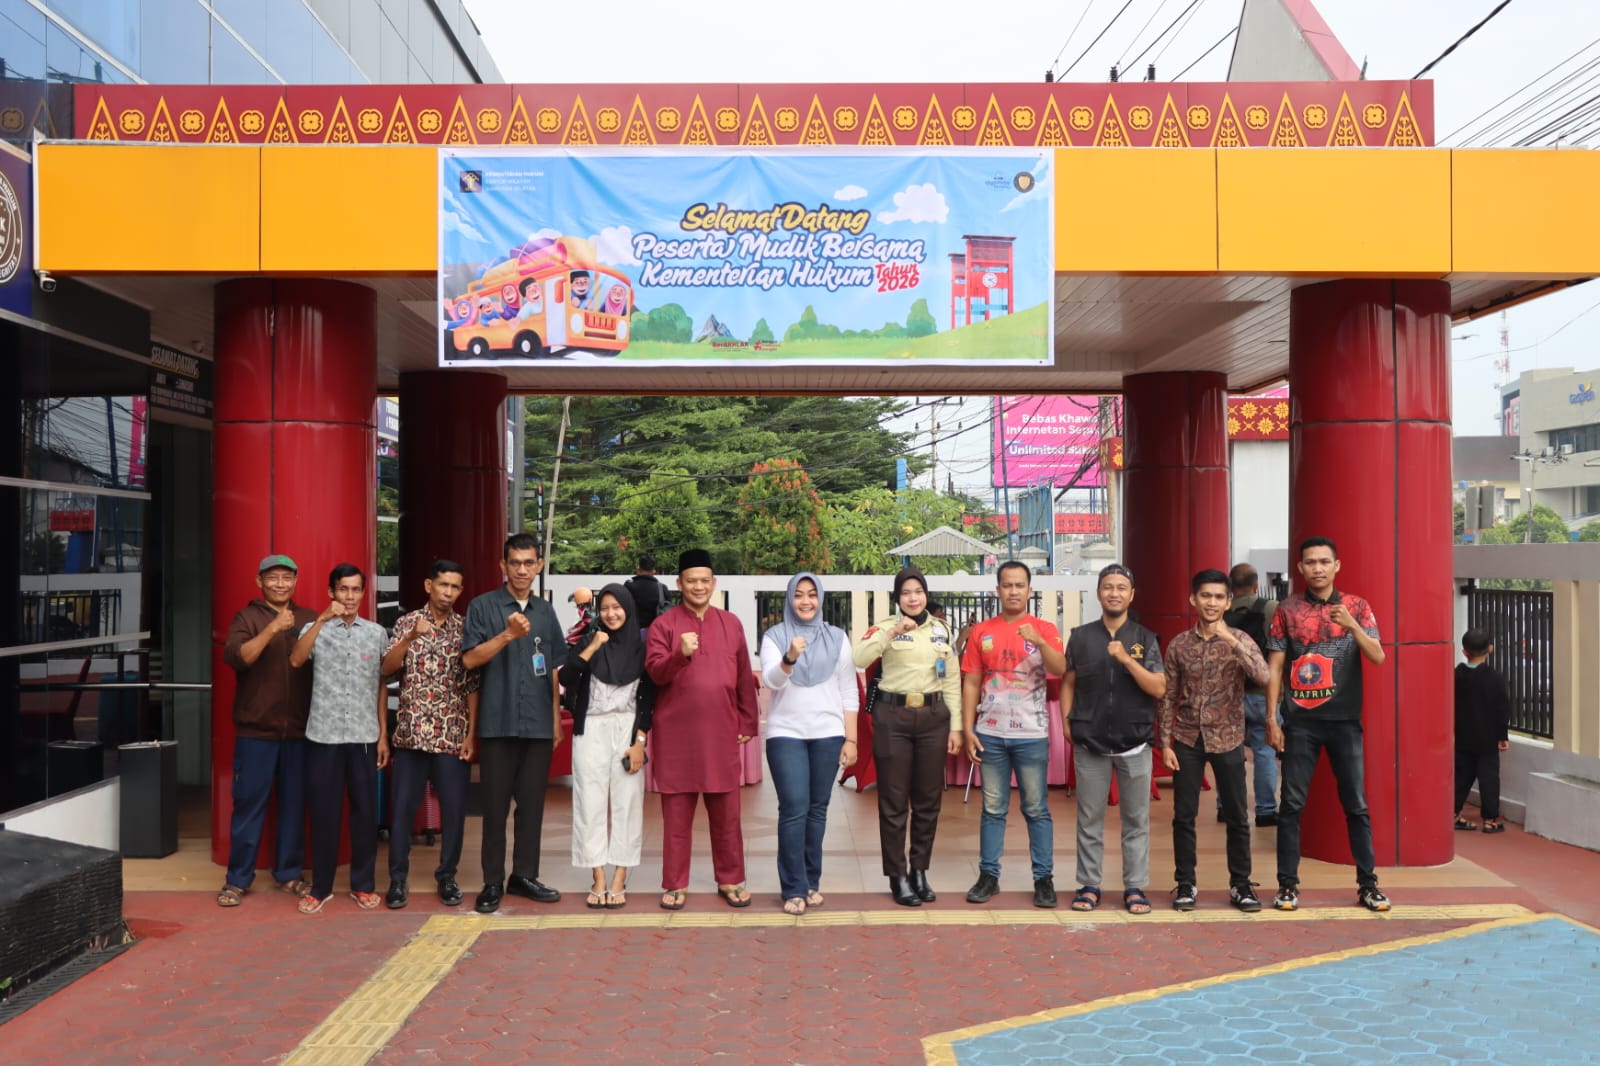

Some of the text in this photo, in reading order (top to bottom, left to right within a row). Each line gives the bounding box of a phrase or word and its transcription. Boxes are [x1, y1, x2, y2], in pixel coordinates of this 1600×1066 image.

[680, 202, 871, 236] Selamat Datang
[632, 231, 927, 265] Peserta Mudik Bersama
[640, 259, 873, 292] Kementerian Hukum
[875, 262, 920, 280] Tahun
[877, 275, 919, 293] 2026
[1022, 413, 1056, 424] Bebas
[1006, 426, 1066, 435] Internetan
[1293, 688, 1332, 699] SATRIA
